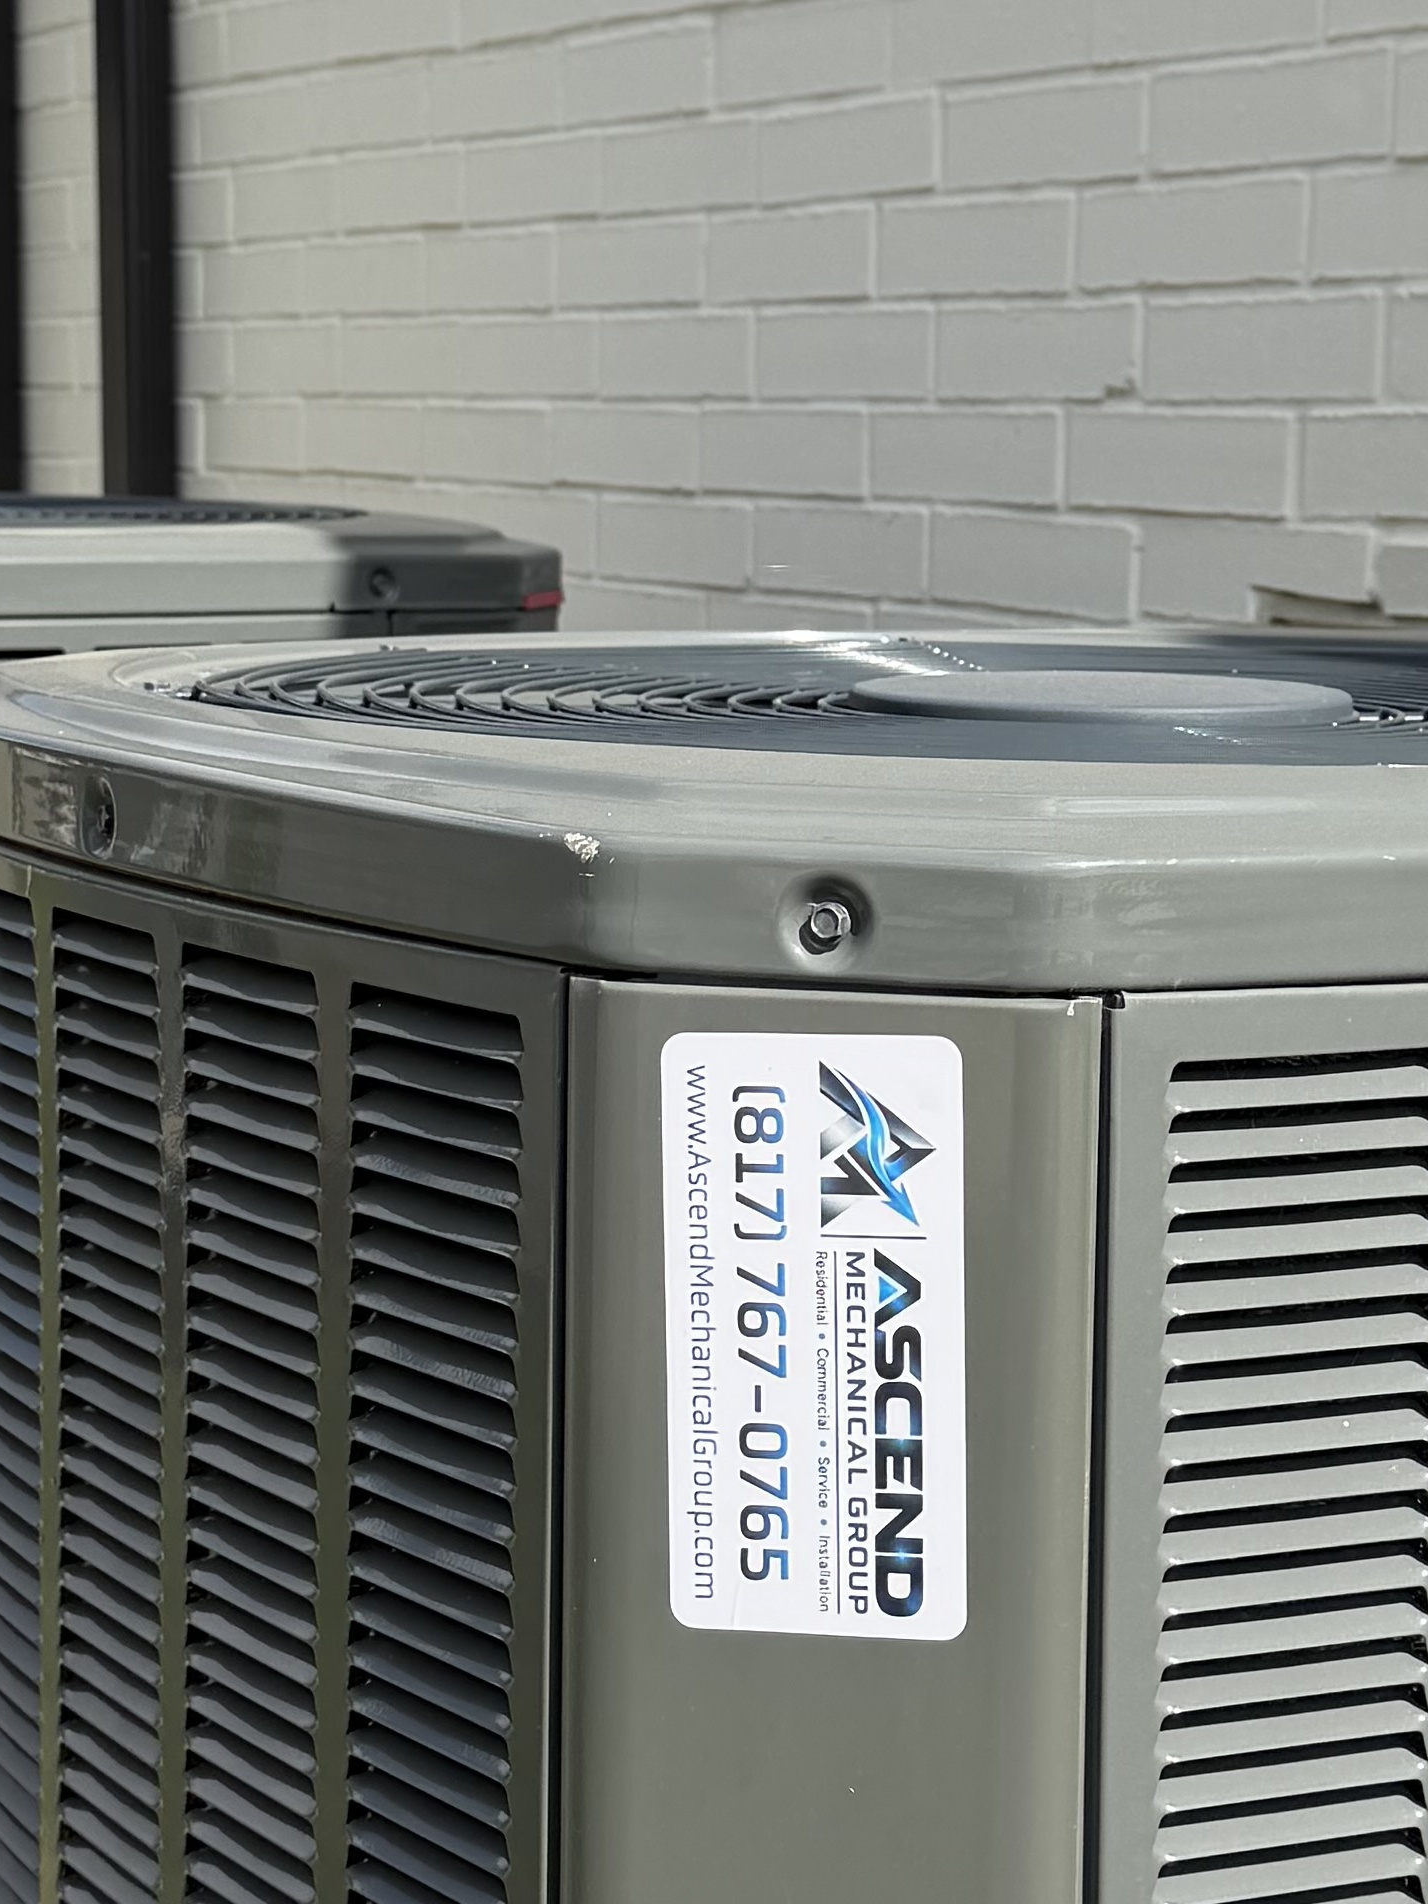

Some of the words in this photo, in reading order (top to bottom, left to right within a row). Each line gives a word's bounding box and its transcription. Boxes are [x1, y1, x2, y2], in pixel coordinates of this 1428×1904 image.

[732, 1085, 788, 1241] (817)
[687, 1065, 717, 1600] www.AscendMechanicalGroup.com
[815, 1251, 829, 1326] Residential
[735, 1262, 790, 1581] 767-0765
[816, 1348, 831, 1431] Commercial
[845, 1251, 869, 1485] MECHANICAL
[873, 1248, 924, 1618] ASCEND
[817, 1457, 831, 1509] Service
[847, 1497, 869, 1615] GROUP
